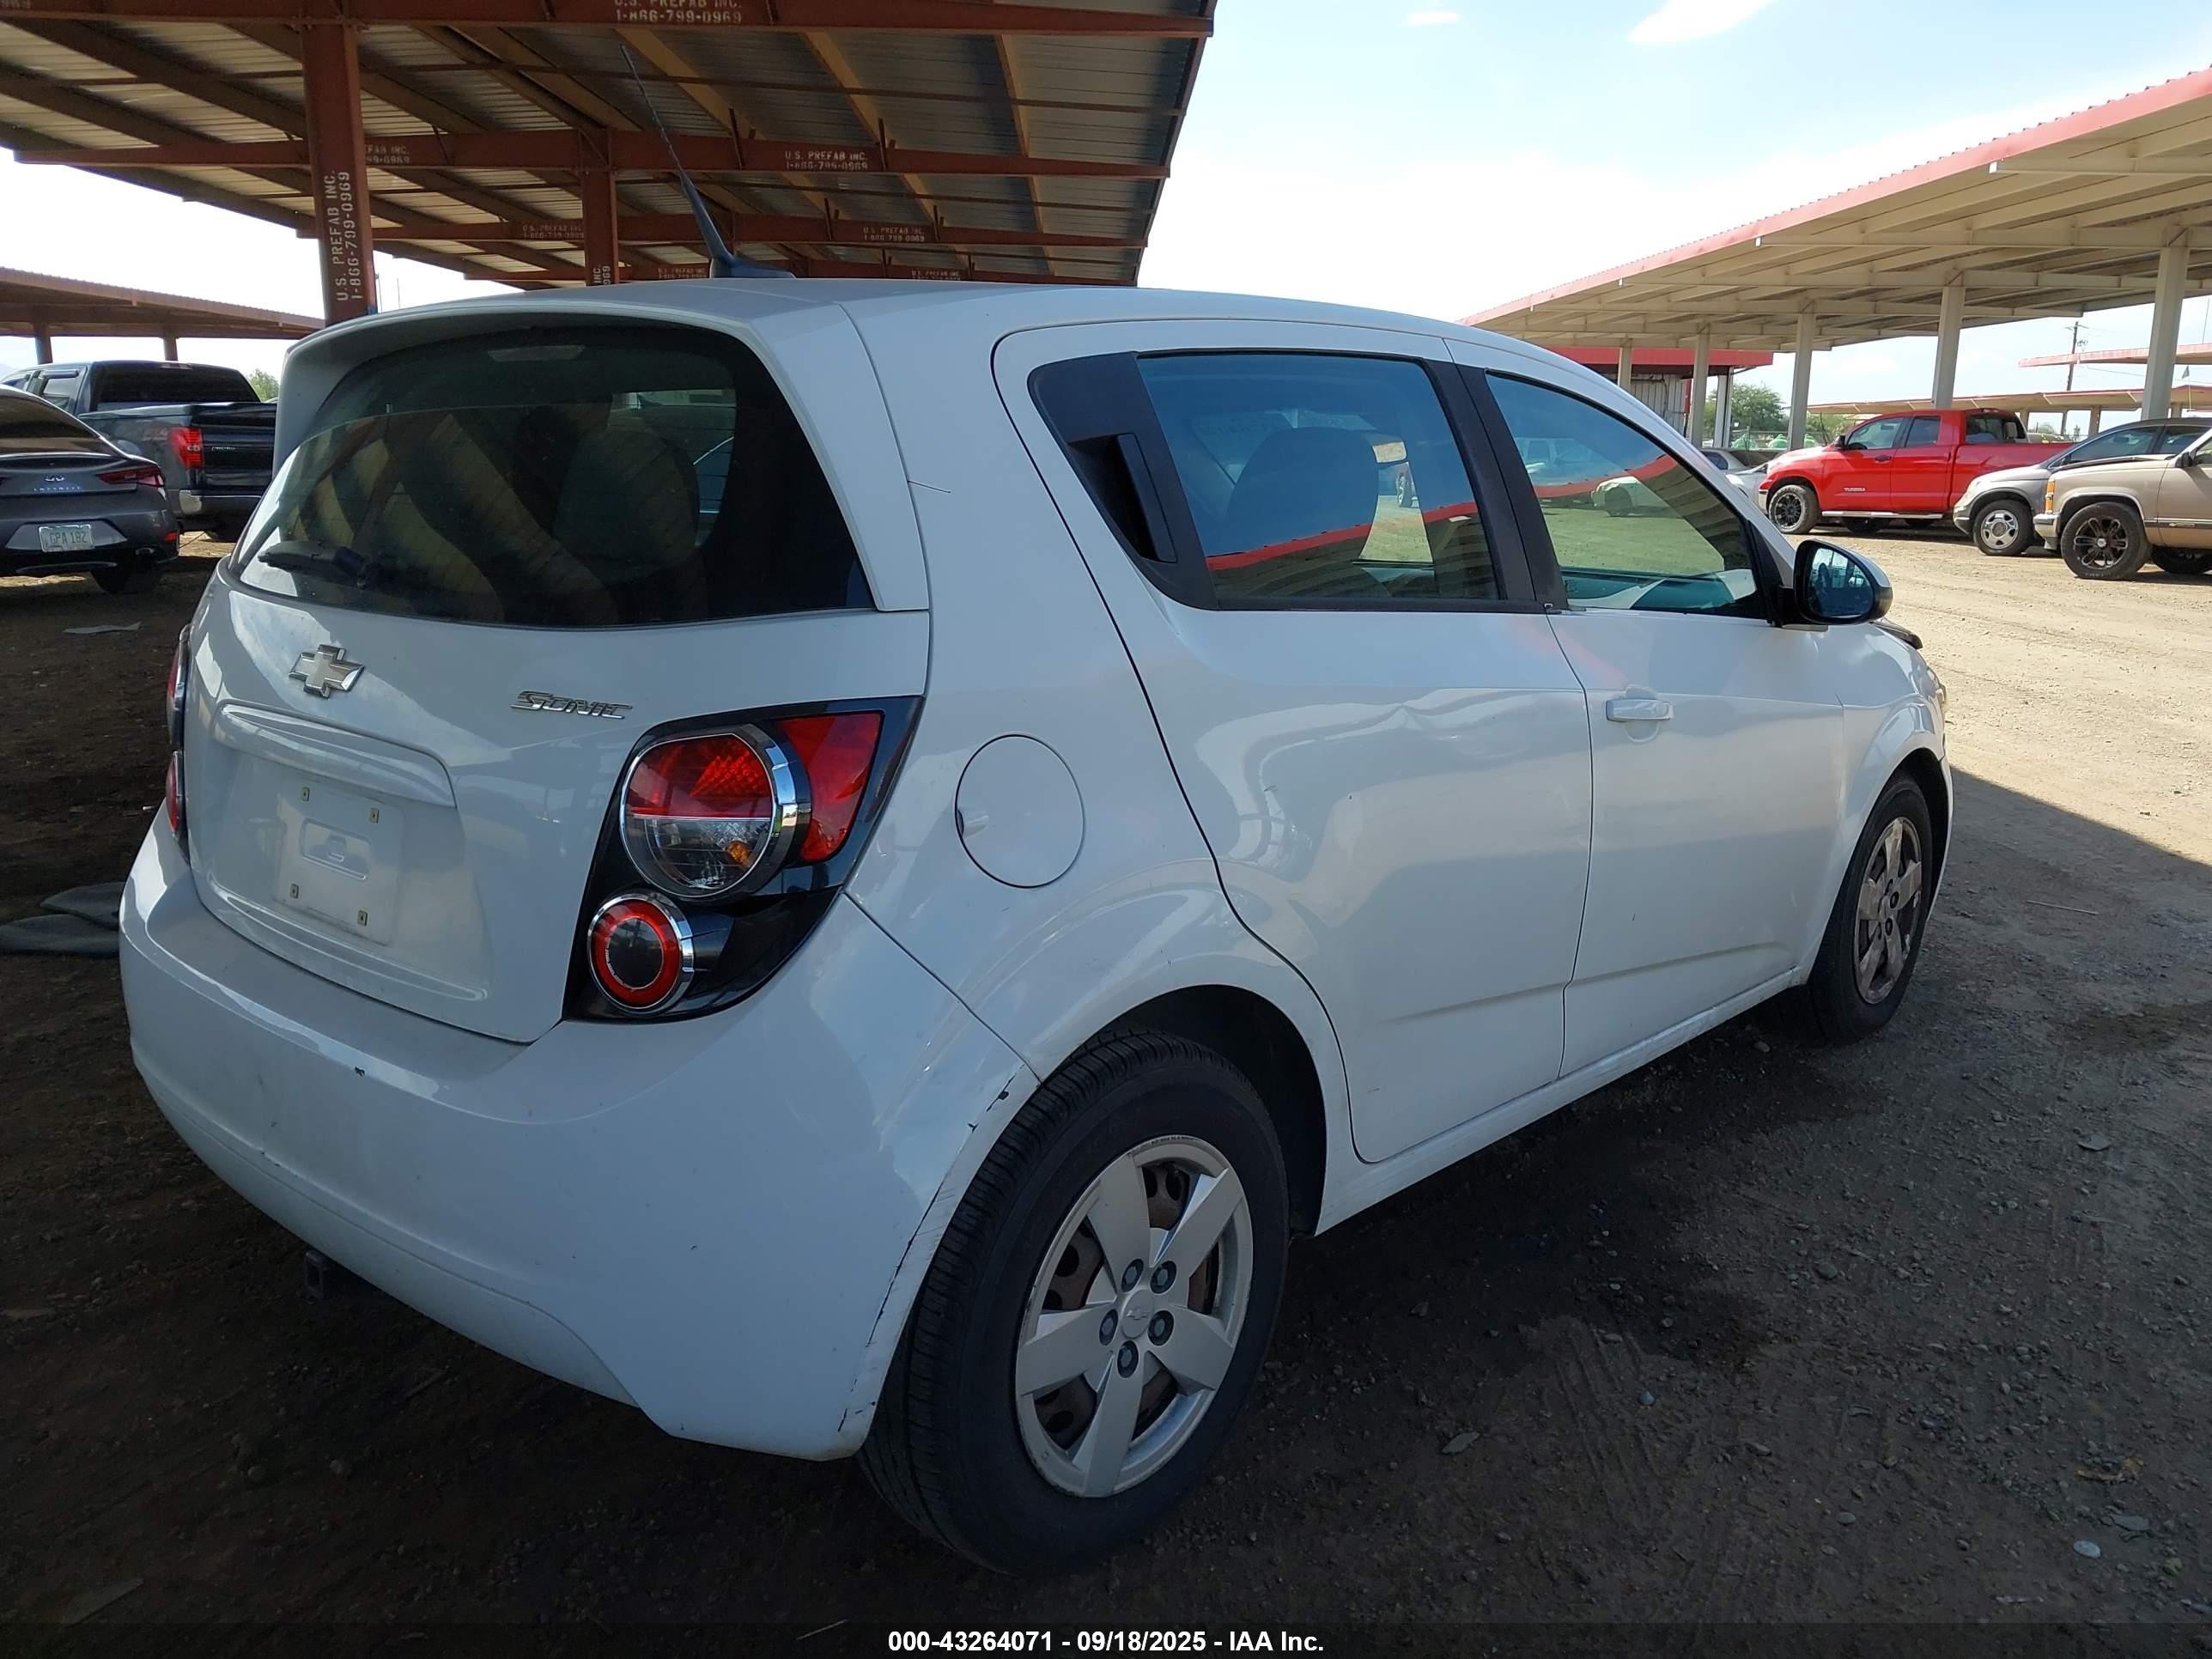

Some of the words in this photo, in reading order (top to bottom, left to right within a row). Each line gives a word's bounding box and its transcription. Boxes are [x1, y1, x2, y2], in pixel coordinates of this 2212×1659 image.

[808, 150, 846, 161] PREFAB
[324, 170, 337, 198] INC.
[326, 207, 345, 264] PREFAB
[337, 172, 363, 299] 1-866-799-0969
[335, 274, 349, 301] U.S.
[509, 690, 633, 720] SONIC
